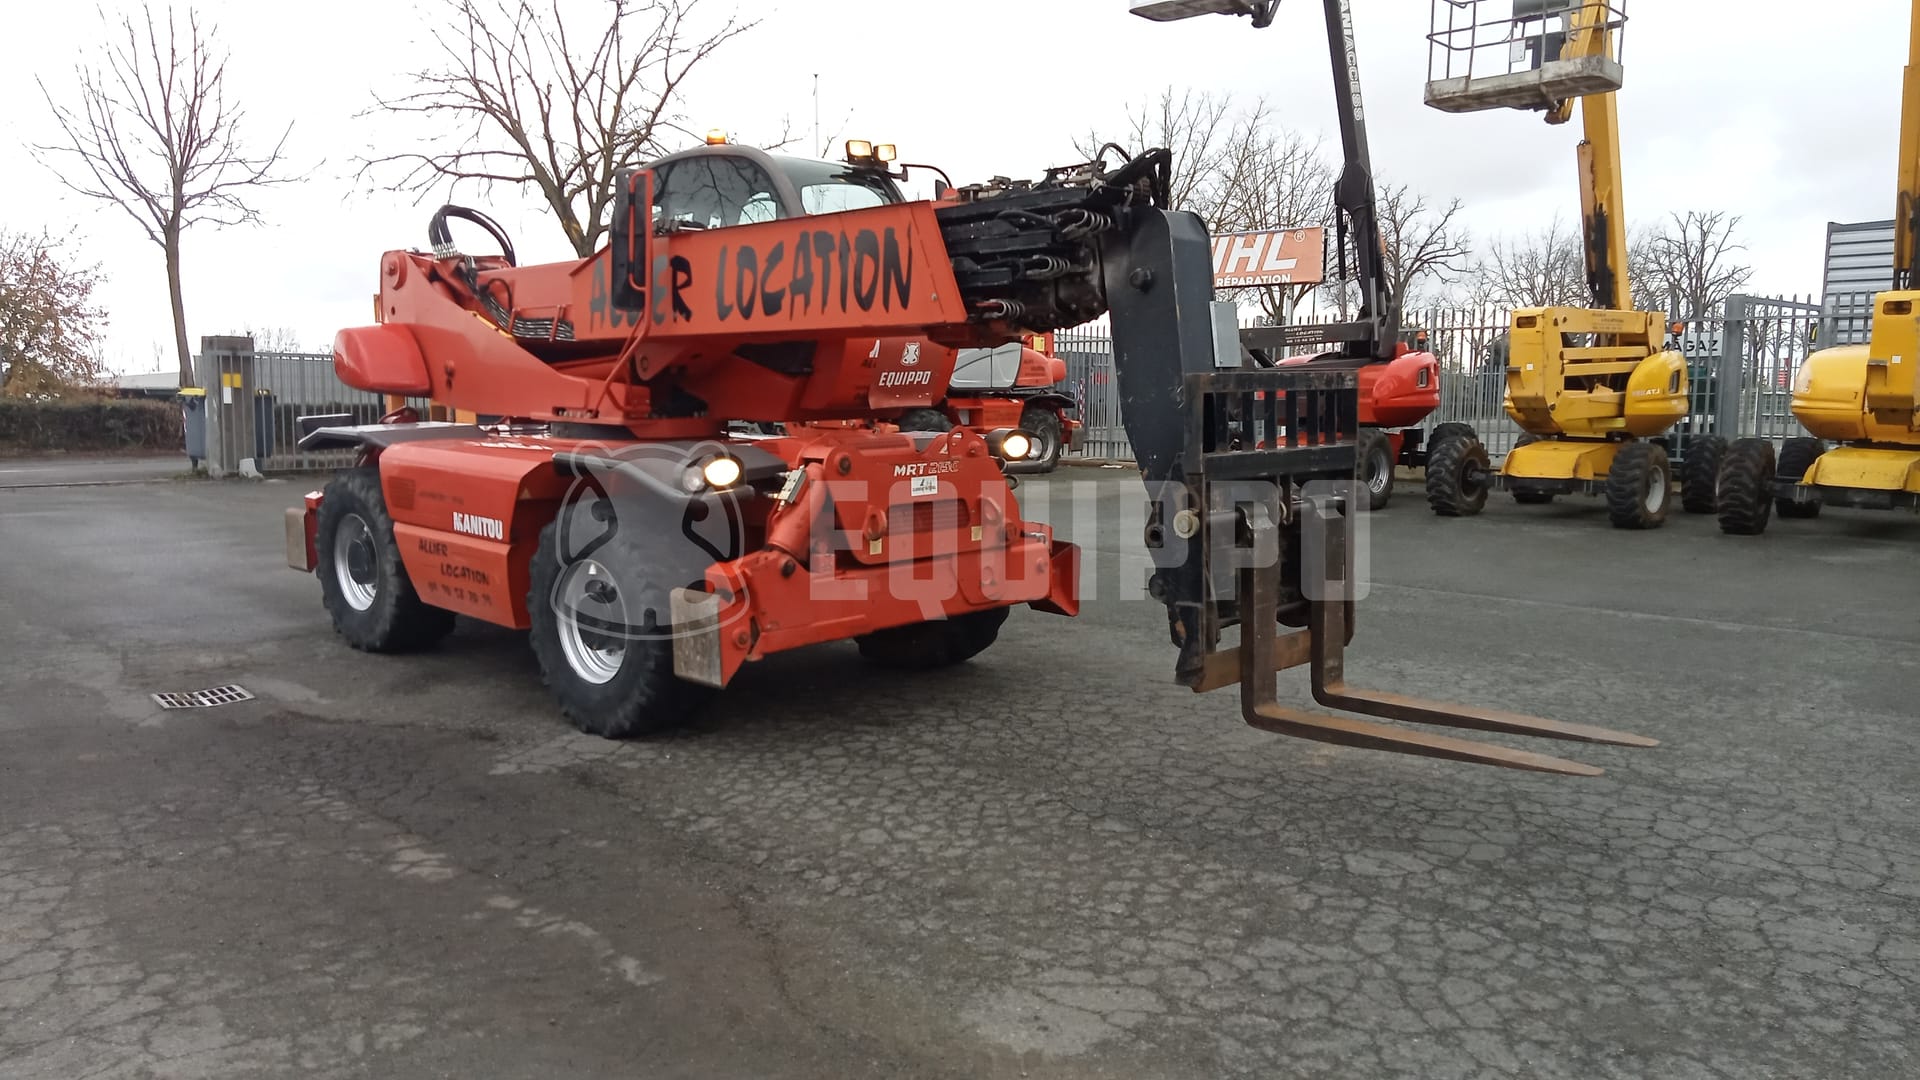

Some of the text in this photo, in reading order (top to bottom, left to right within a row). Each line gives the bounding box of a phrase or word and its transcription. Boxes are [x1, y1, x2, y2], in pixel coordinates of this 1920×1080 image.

[715, 222, 913, 322] LOCATION
[1216, 274, 1291, 287] RÉPARATION
[878, 371, 931, 387] EQUIPPO
[893, 463, 927, 477] MRT
[453, 511, 504, 540] MANITOU
[418, 538, 448, 557] ALLIER
[440, 562, 490, 586] LOCATION
